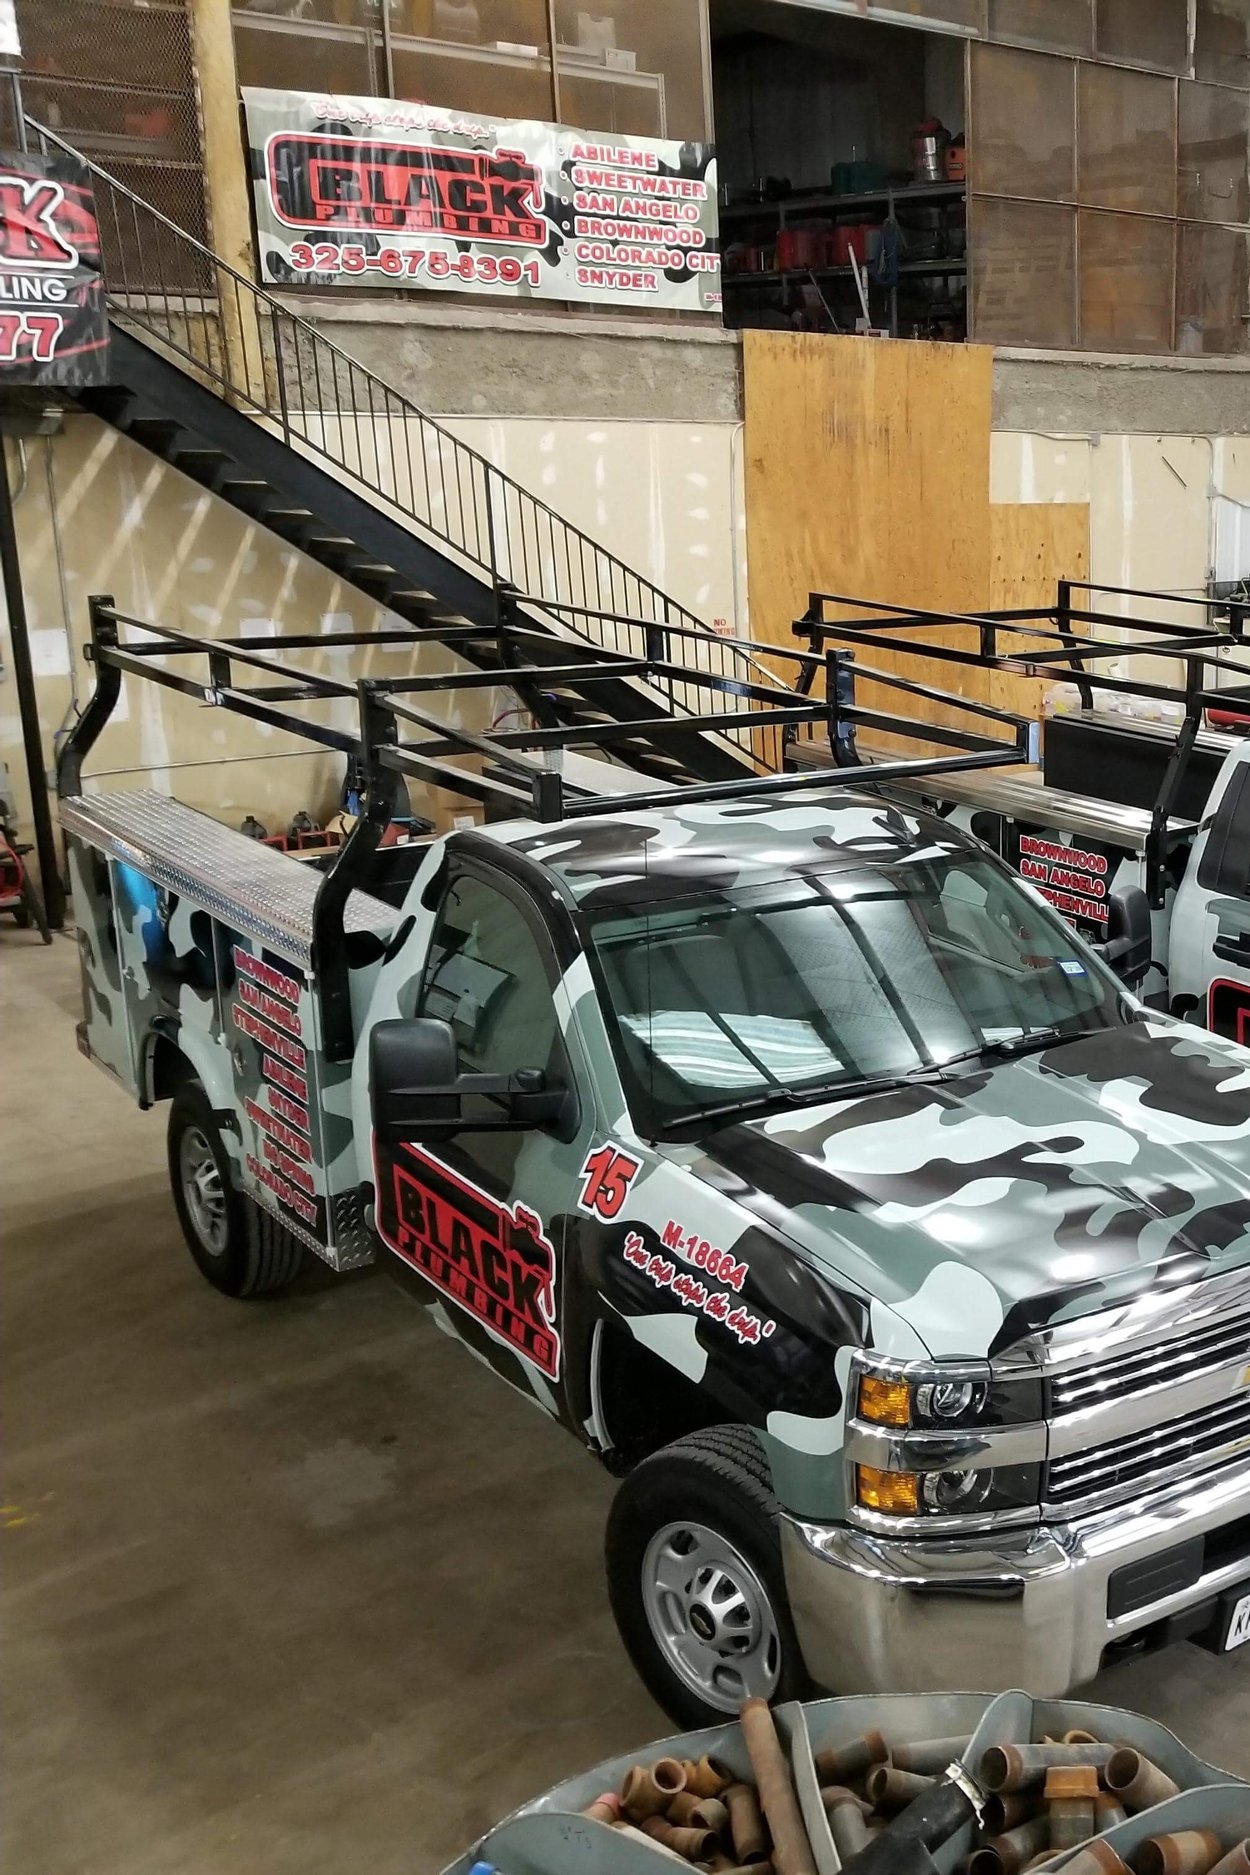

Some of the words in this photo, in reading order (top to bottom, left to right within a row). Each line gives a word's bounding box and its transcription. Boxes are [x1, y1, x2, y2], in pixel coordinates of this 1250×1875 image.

[571, 143, 657, 168] ABILENE
[316, 166, 534, 219] BLACK
[573, 168, 707, 199] SWEETWATER
[315, 204, 538, 238] PLUMBING
[574, 192, 616, 213] SAN
[620, 198, 699, 221] ANGELO
[576, 218, 704, 246] BROWNWOOD
[291, 243, 540, 285] 325-675-8391
[576, 244, 683, 268] COLORADO
[688, 253, 721, 271] CIT
[577, 269, 658, 289] SNYDER
[714, 618, 727, 626] NO
[1020, 835, 1107, 874] BROWNWOOD
[1021, 859, 1048, 883] SAN
[1049, 867, 1106, 898] ANGELO
[582, 1146, 639, 1219] 15
[400, 1183, 548, 1327] BLACK
[661, 1219, 749, 1292] M-18664
[399, 1228, 552, 1364] PLUMBING
